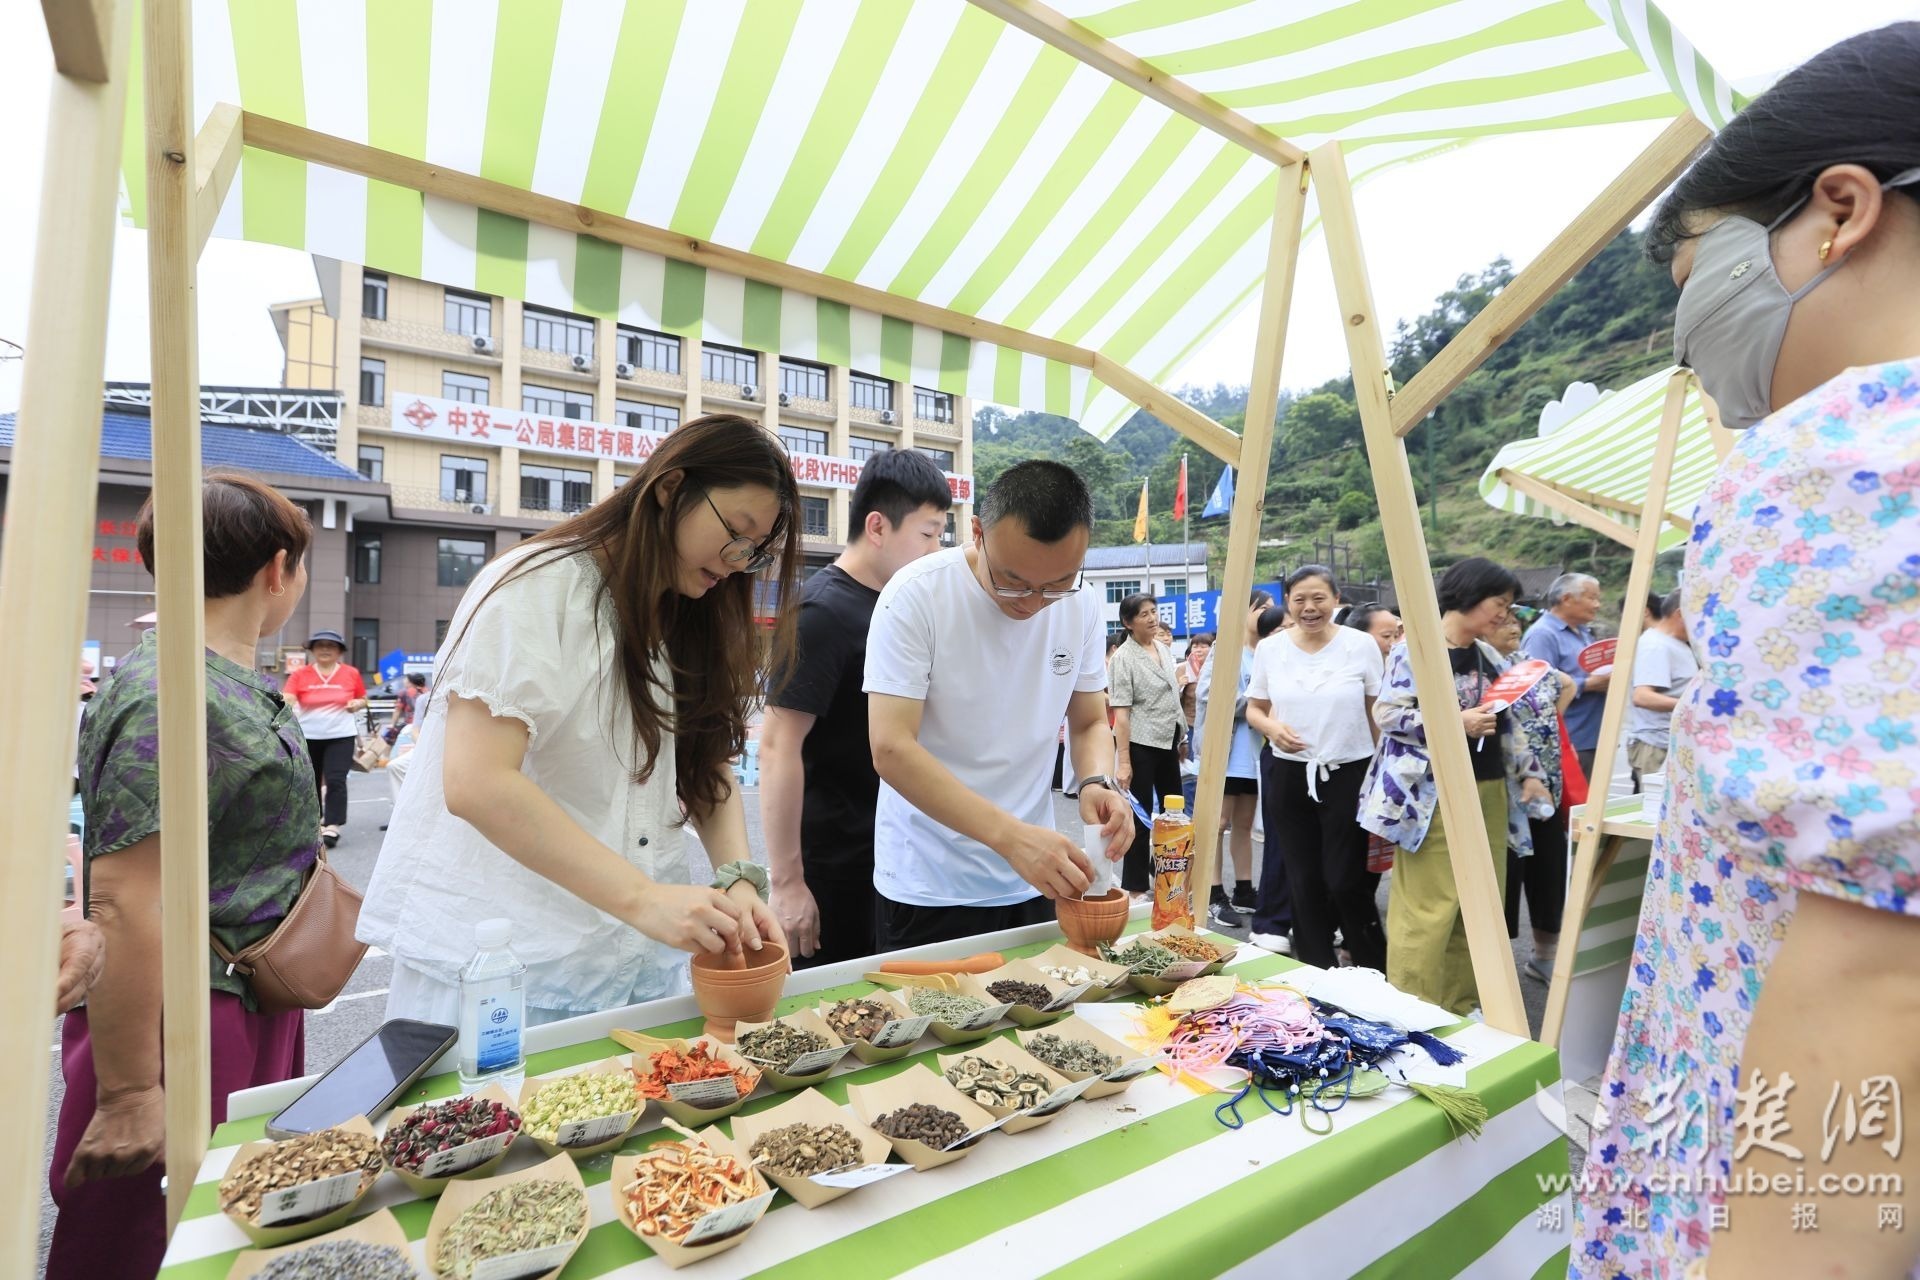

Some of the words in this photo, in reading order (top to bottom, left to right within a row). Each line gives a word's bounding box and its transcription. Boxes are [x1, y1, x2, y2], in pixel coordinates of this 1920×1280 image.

[447, 406, 667, 458] 中交一公局集团有限公
[791, 456, 865, 484] 北段YFHB
